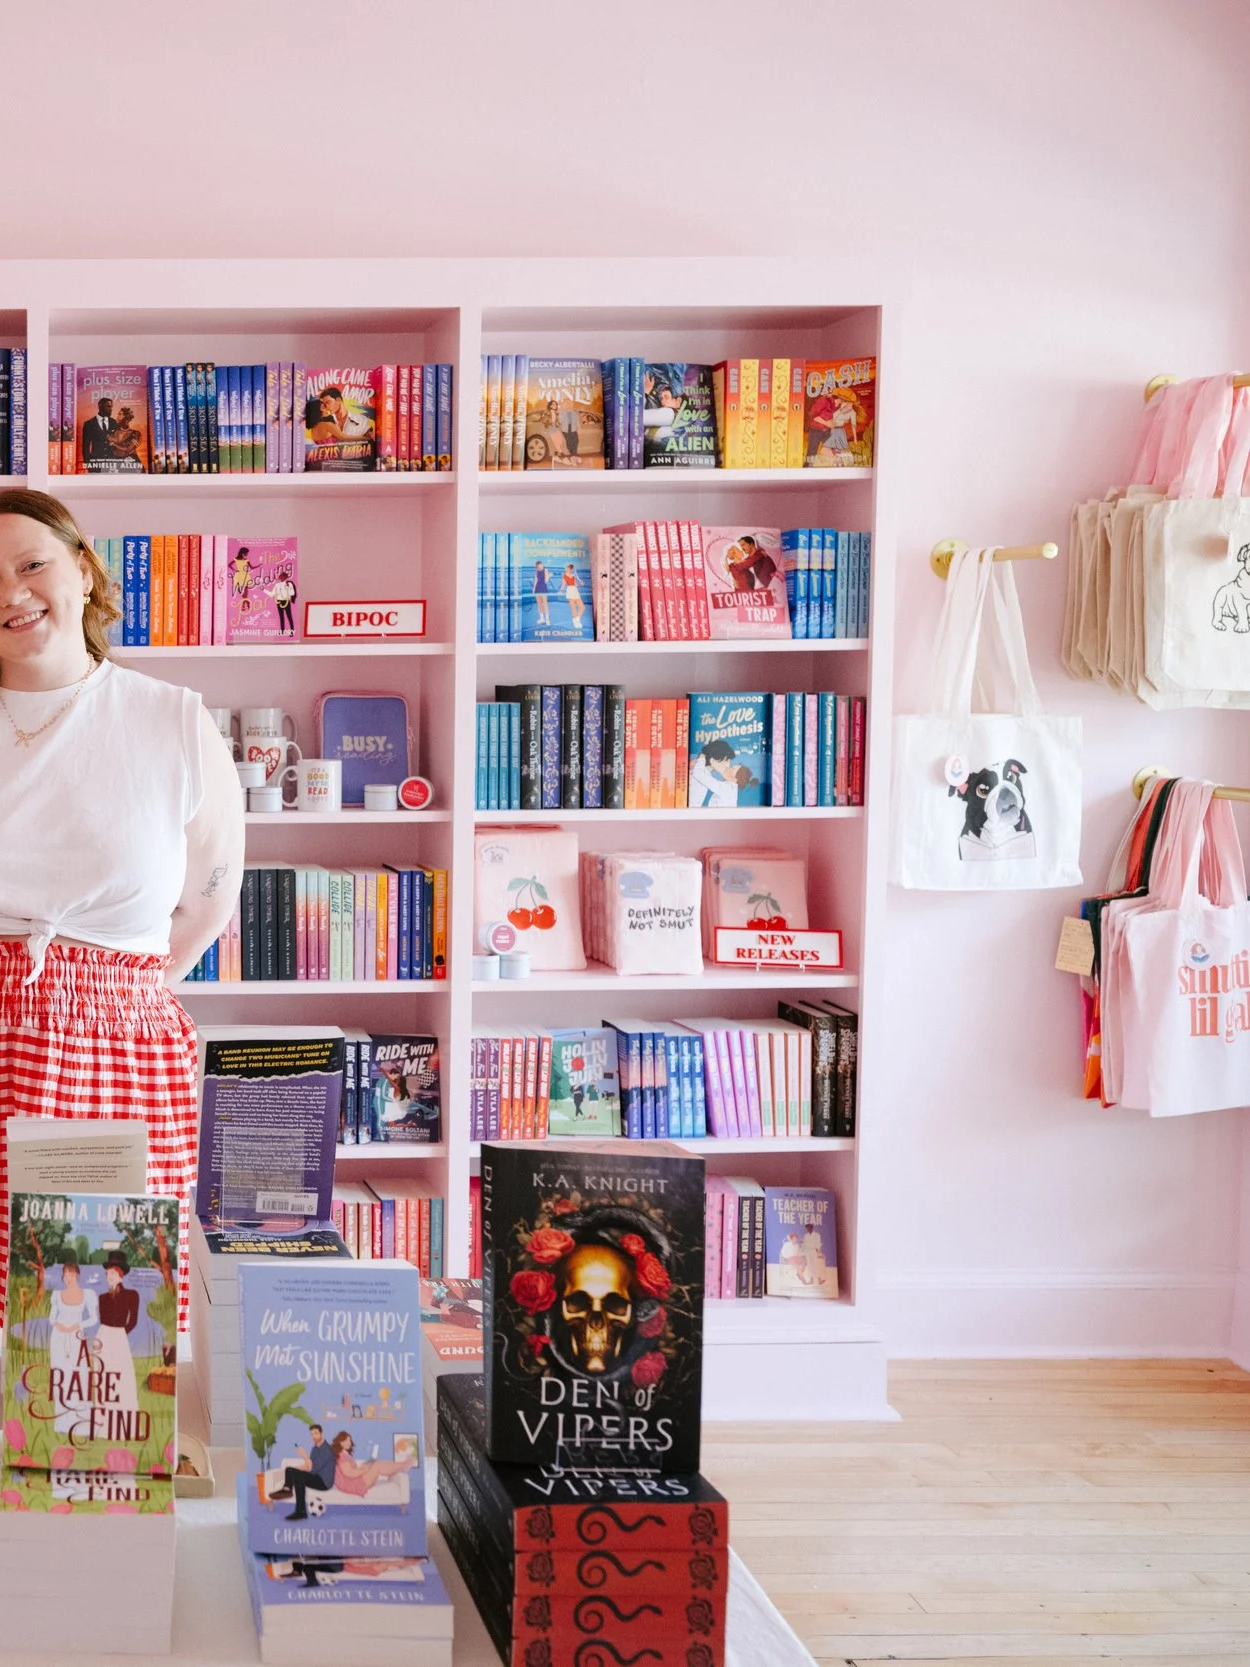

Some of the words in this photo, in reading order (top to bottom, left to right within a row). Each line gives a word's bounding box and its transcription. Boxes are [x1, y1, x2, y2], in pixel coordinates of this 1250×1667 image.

[83, 374, 110, 388] plus
[116, 372, 141, 385] size
[307, 369, 341, 399] ALONG
[340, 368, 373, 387] CAME
[807, 360, 871, 398] CASH
[91, 388, 135, 402] player
[341, 384, 374, 405] AMOR
[683, 386, 710, 395] Think
[672, 400, 711, 428] Love
[307, 449, 338, 461] ALEXIS
[342, 445, 372, 459] DARIA
[666, 437, 714, 451] ALIEN
[228, 563, 293, 597] Wedding
[715, 593, 767, 607] TOURIST
[332, 611, 398, 626] BIPOC
[745, 609, 777, 622] TRAP
[701, 713, 716, 725] the
[717, 705, 756, 727] Love
[696, 721, 763, 743] Hypothesis
[343, 736, 387, 752] BUSY
[307, 787, 328, 796] READ
[628, 907, 695, 919] DEFINITELY
[629, 921, 654, 931] NOT
[660, 918, 694, 930] SMUT
[758, 934, 795, 945] NEW
[736, 949, 819, 961] RELEASES
[1189, 997, 1219, 1036] lil
[376, 1043, 409, 1061] RIDE
[410, 1044, 434, 1056] WITH
[561, 1039, 607, 1059] HOLLY
[296, 1058, 329, 1066] ROMANCE.
[402, 1057, 429, 1075] ME
[533, 1173, 576, 1189] K.A.
[584, 1176, 668, 1194] KNIGHT
[20, 1200, 89, 1222] JOANNA
[96, 1203, 170, 1225] LOWELL
[772, 1199, 814, 1211] TEACHER
[817, 1201, 828, 1211] OF
[778, 1211, 796, 1224] THE
[798, 1214, 823, 1225] YEAR
[260, 1309, 310, 1335] When
[318, 1310, 410, 1345] GRUMPY
[255, 1345, 302, 1370] Met
[296, 1350, 416, 1384] SUNSHINE
[22, 1364, 121, 1420] RARE
[541, 1377, 619, 1408] DEN
[634, 1384, 656, 1411] of
[68, 1407, 151, 1451] FIND
[517, 1410, 674, 1451] VIPERS
[524, 1478, 689, 1496] VIPERS
[274, 1529, 355, 1547] CHARLOTTE
[360, 1529, 403, 1547] STEIN
[379, 1591, 425, 1600] STEIN
